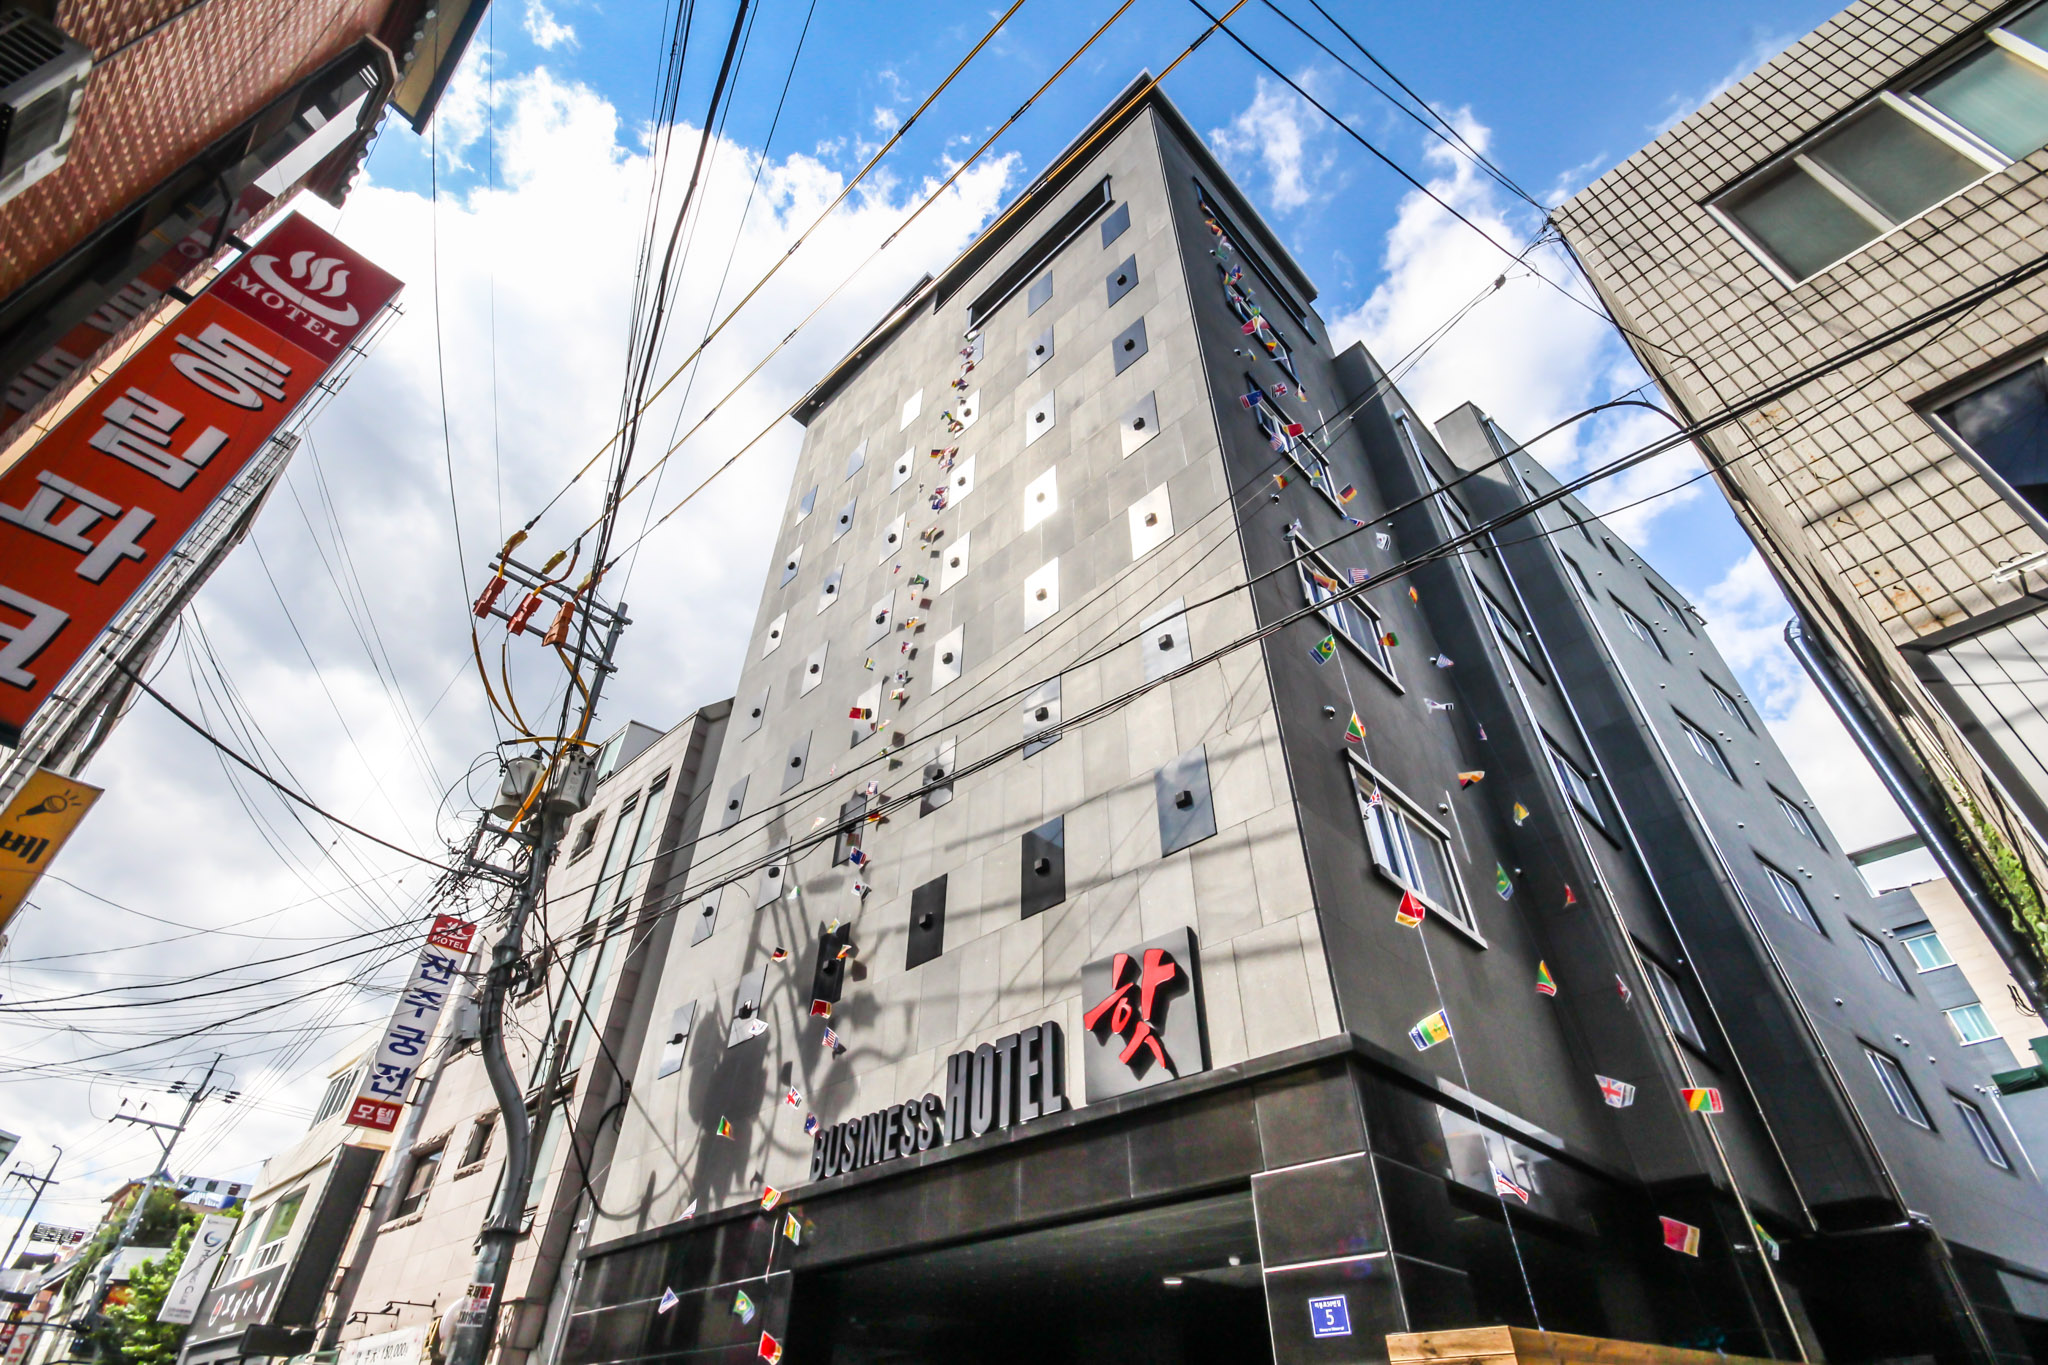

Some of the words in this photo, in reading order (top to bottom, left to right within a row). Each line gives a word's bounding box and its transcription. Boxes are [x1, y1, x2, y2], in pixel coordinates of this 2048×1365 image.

[231, 273, 342, 347] MOTEL
[432, 935, 465, 950] MOTEL
[809, 1092, 945, 1182] BUSINESS
[944, 1020, 1065, 1147] HOTEL
[353, 1103, 396, 1126] 모텔
[1325, 1308, 1335, 1326] 5
